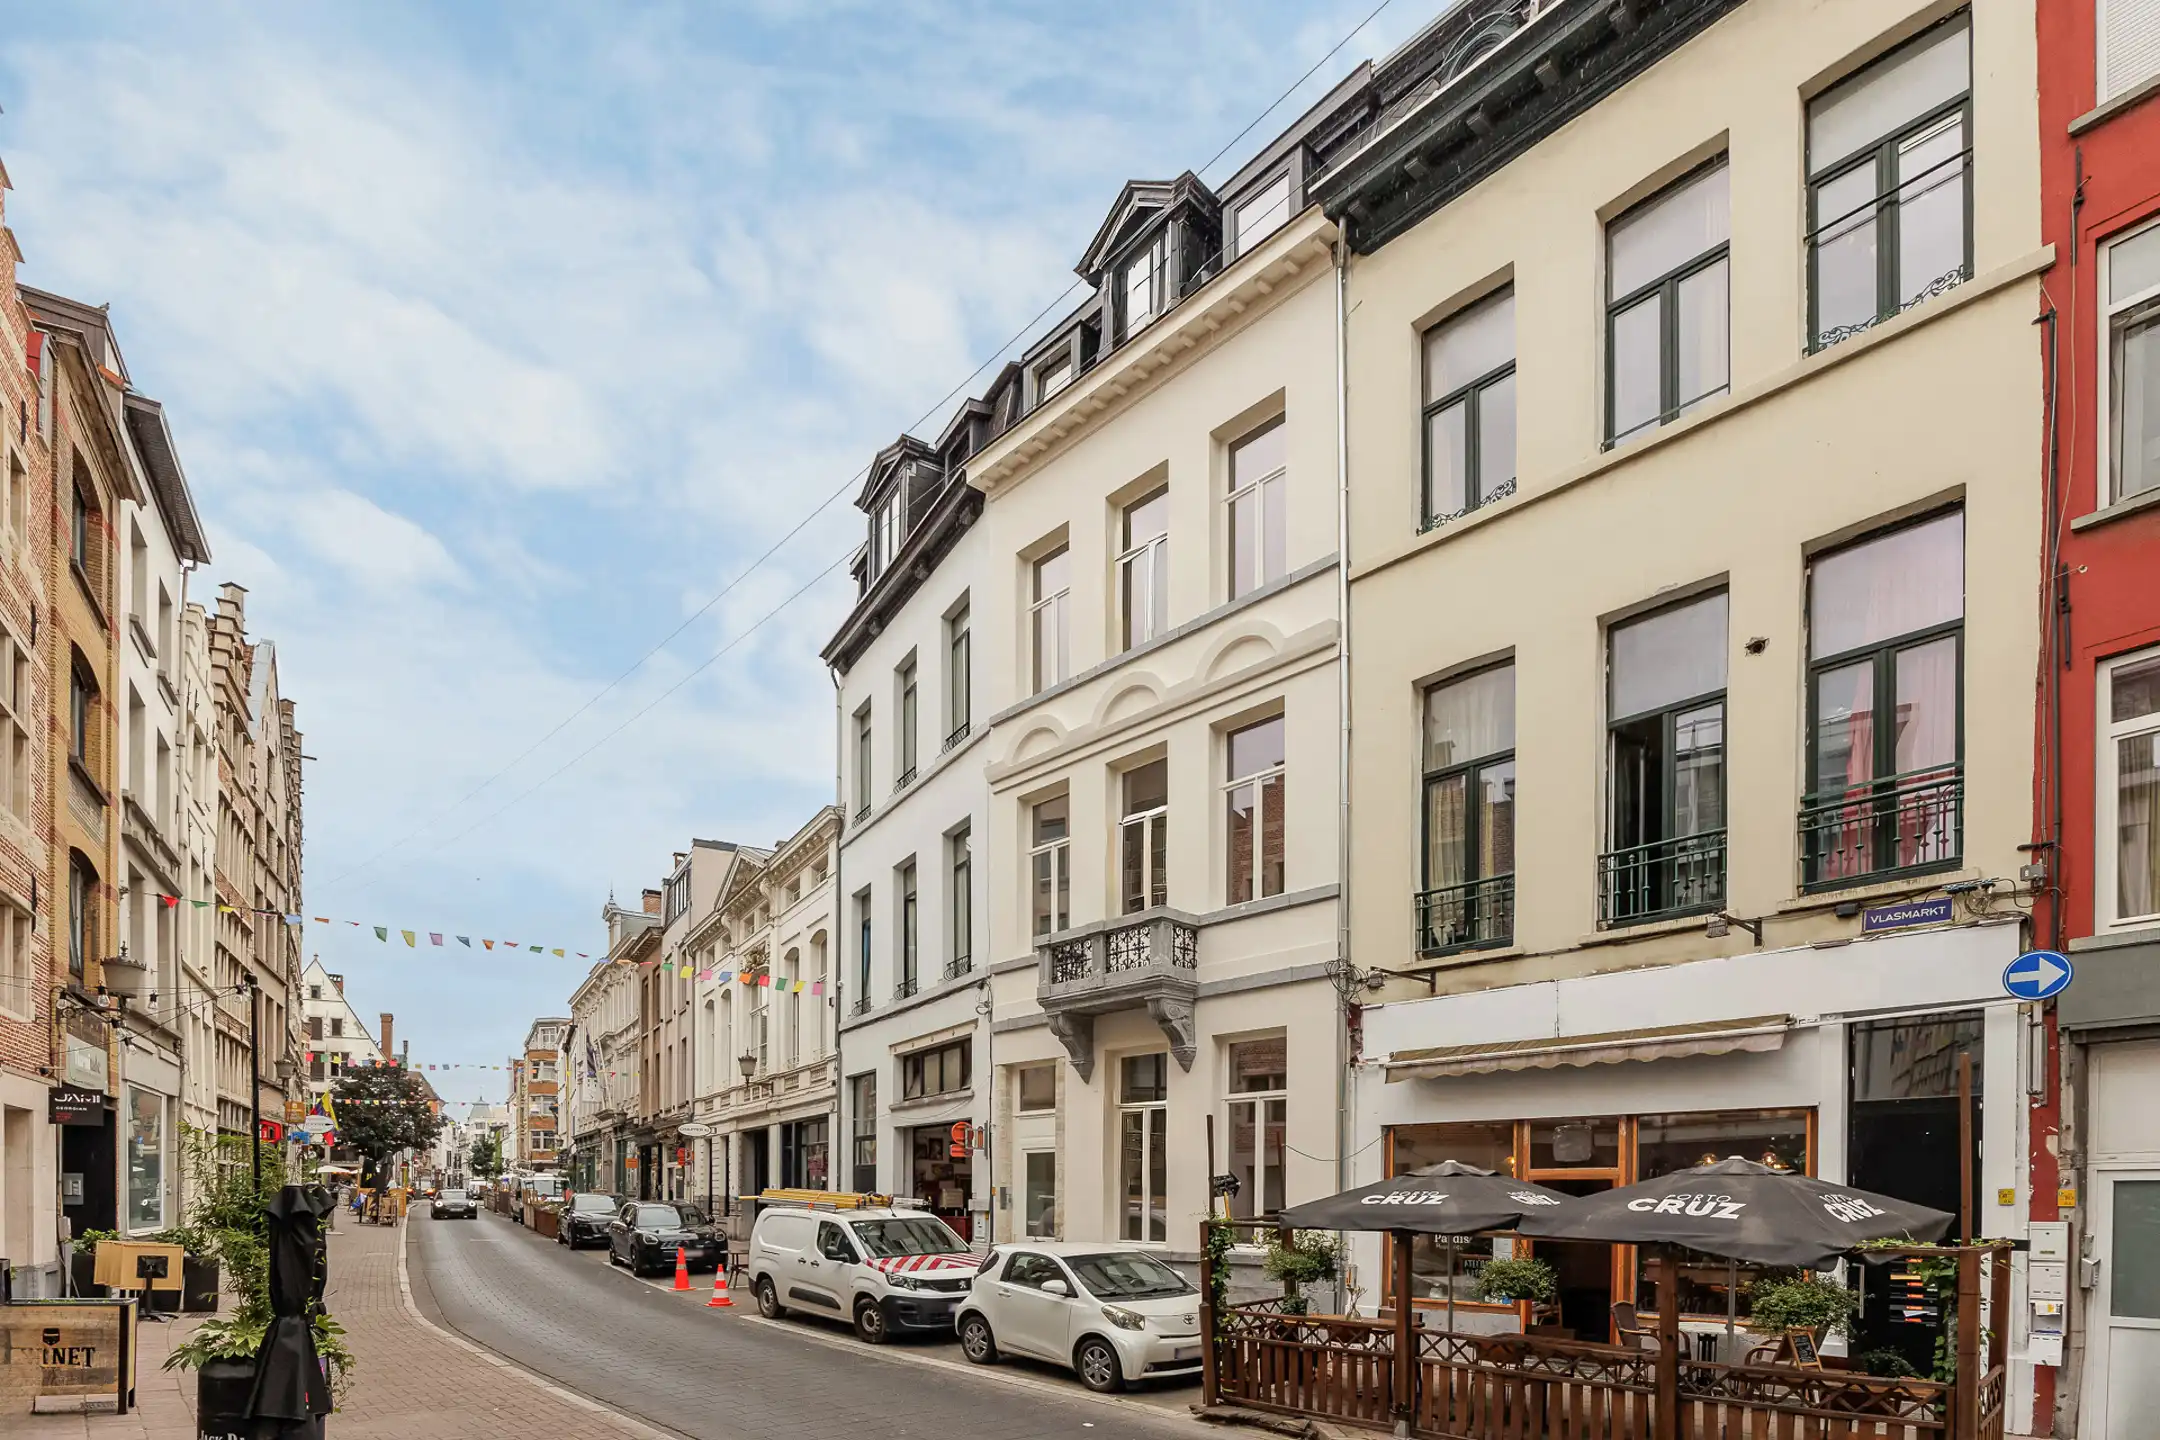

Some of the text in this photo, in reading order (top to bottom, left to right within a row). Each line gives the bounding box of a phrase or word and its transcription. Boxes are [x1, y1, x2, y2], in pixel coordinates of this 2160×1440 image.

[1871, 906, 1946, 924] VLASMARKT
[1361, 1195, 1450, 1205] CRUZ
[1391, 1190, 1440, 1198] PORTO
[1665, 1193, 1732, 1203] PORTO
[1627, 1198, 1747, 1220] CRUZ
[1824, 1199, 1886, 1223] CRUZ
